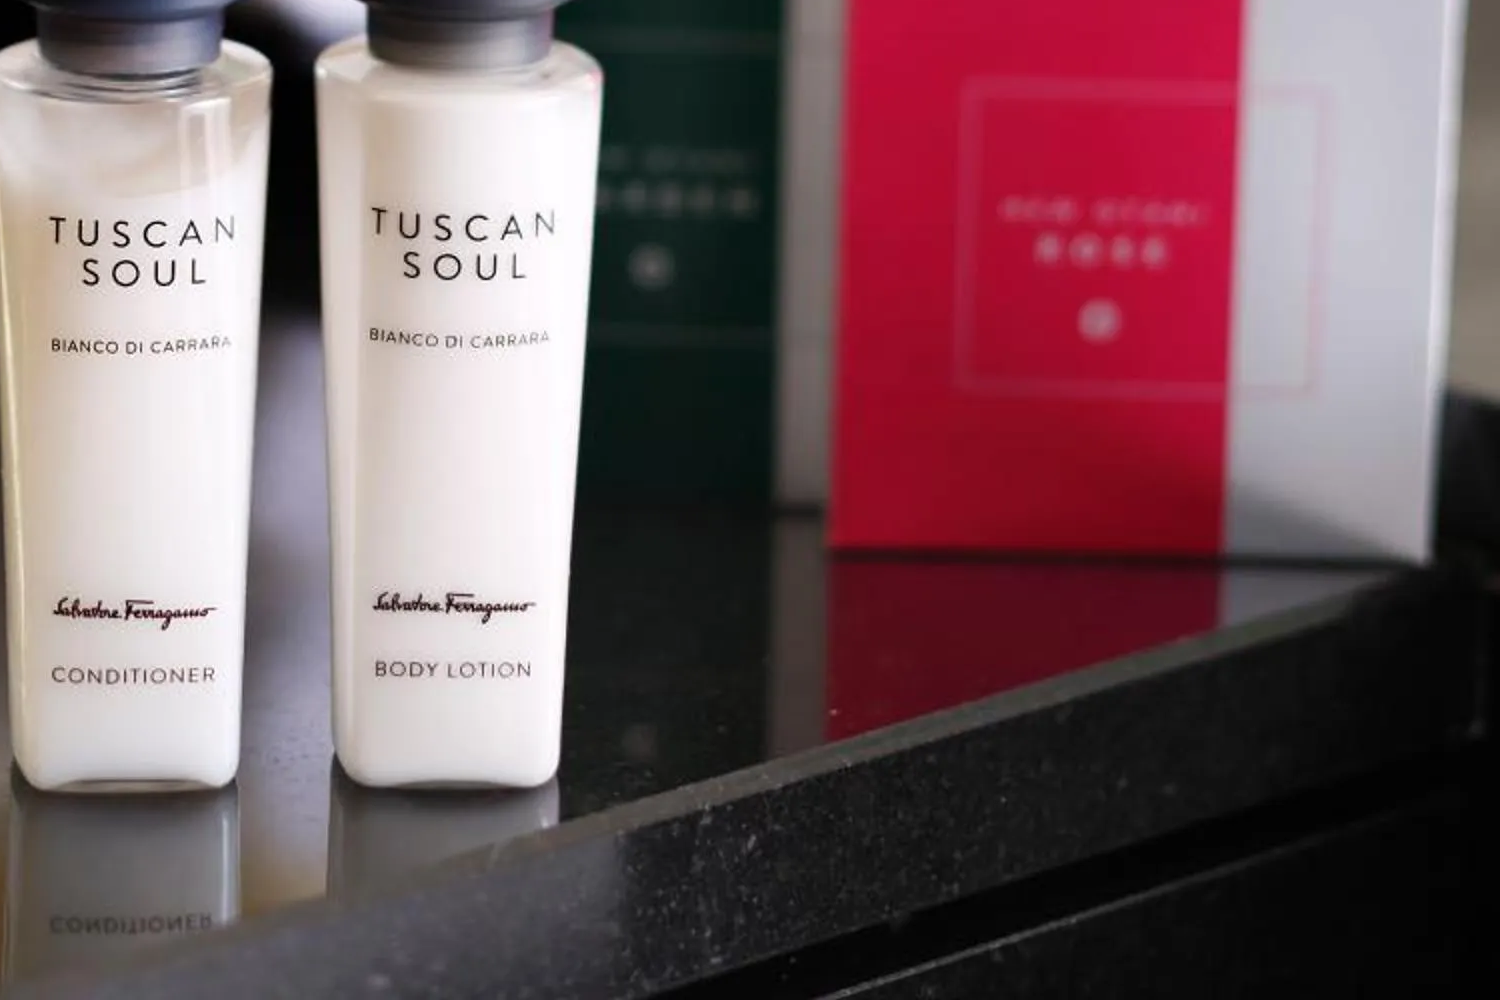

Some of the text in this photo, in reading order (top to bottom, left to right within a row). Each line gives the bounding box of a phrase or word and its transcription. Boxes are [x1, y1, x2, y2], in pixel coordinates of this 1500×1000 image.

[48, 215, 235, 248] TUSCAN
[371, 207, 556, 242] TUSCAN
[82, 258, 207, 287] SOUL
[403, 251, 526, 281] SOUL
[51, 335, 232, 355] BIANCO DI CARRARA
[369, 327, 550, 349] BIANCO DI CARRARA
[53, 597, 218, 631] Salvatore Ferragamo
[372, 591, 537, 624] Salvatore Ferragamo
[51, 666, 216, 685] CONDITIONER
[375, 660, 531, 679] BODY LOTION
